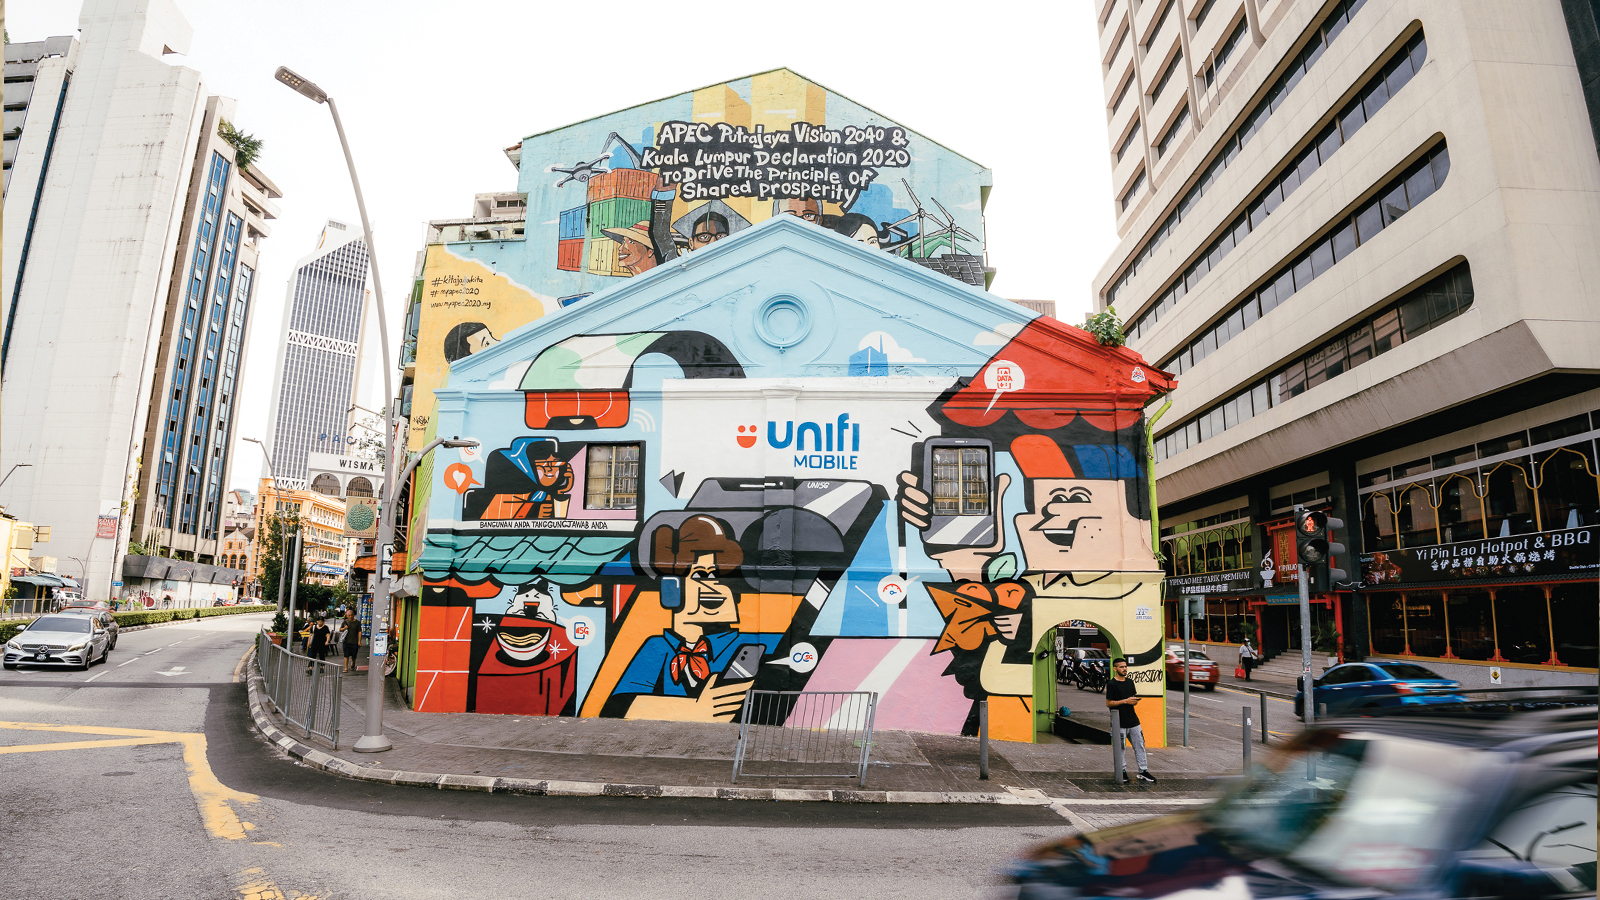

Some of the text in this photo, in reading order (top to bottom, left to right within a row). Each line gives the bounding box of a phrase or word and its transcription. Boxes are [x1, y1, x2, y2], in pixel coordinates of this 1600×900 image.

[660, 123, 907, 149] APEC Putrajaya Vision 2040 &
[641, 146, 909, 167] Kuala Lumpur Declaration 2020
[734, 165, 763, 180] The
[766, 166, 841, 184] Principle
[682, 179, 752, 198] Shared
[767, 412, 860, 451] unifi
[339, 459, 374, 471] WISMA
[794, 454, 858, 470] MOBILE
[479, 521, 513, 529] BANGUNAN
[514, 521, 530, 529] ANDA
[591, 521, 608, 530] ANDA
[1416, 530, 1591, 560] Yi Pin Lao Hotpot & BBQ
[1192, 576, 1203, 584] MEE
[1220, 571, 1250, 582] PREMIUM
